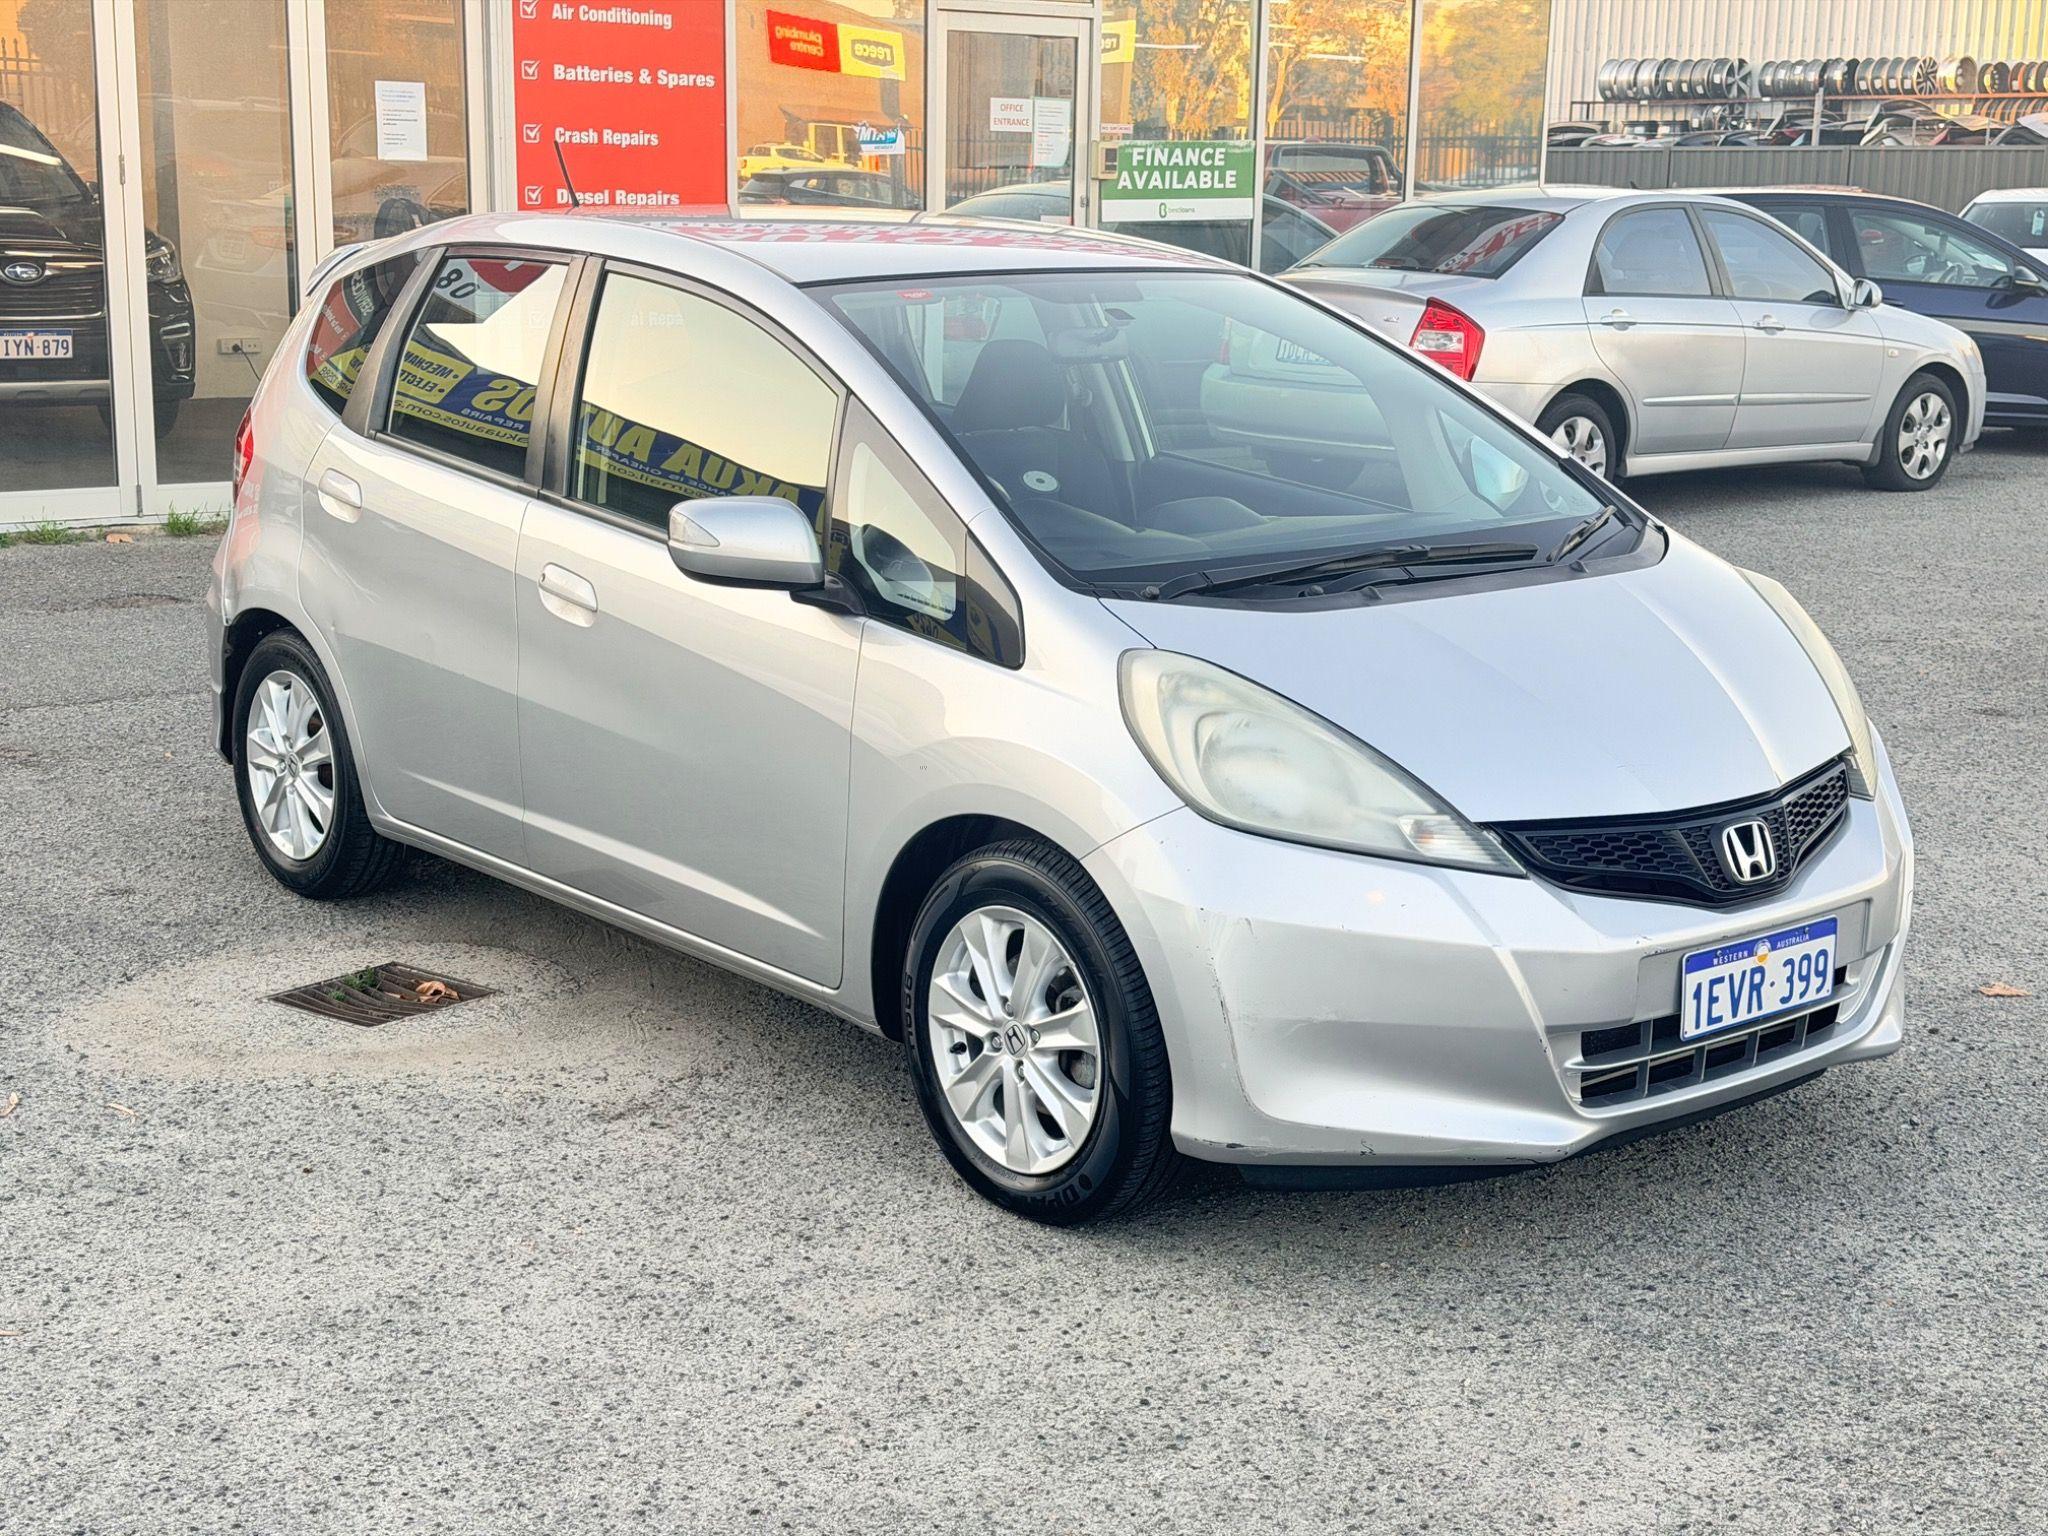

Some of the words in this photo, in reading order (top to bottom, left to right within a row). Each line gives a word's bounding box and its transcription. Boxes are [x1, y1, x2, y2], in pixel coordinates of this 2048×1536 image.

[552, 4, 574, 20] Air
[579, 5, 673, 29] Conditioning
[553, 64, 633, 83] Batteries
[638, 68, 652, 84] &
[657, 70, 715, 88] Spares
[1000, 104, 1024, 112] OFFICE
[993, 118, 1030, 127] ENTRANCE
[554, 127, 598, 144] Crash
[603, 129, 659, 147] Repairs
[1132, 147, 1226, 166] FINANCE
[1117, 170, 1237, 190] AVAILABLE
[615, 190, 680, 206] Repairs
[1712, 949, 1749, 966] WESTERN
[1776, 933, 1811, 949] AUSTRALIA
